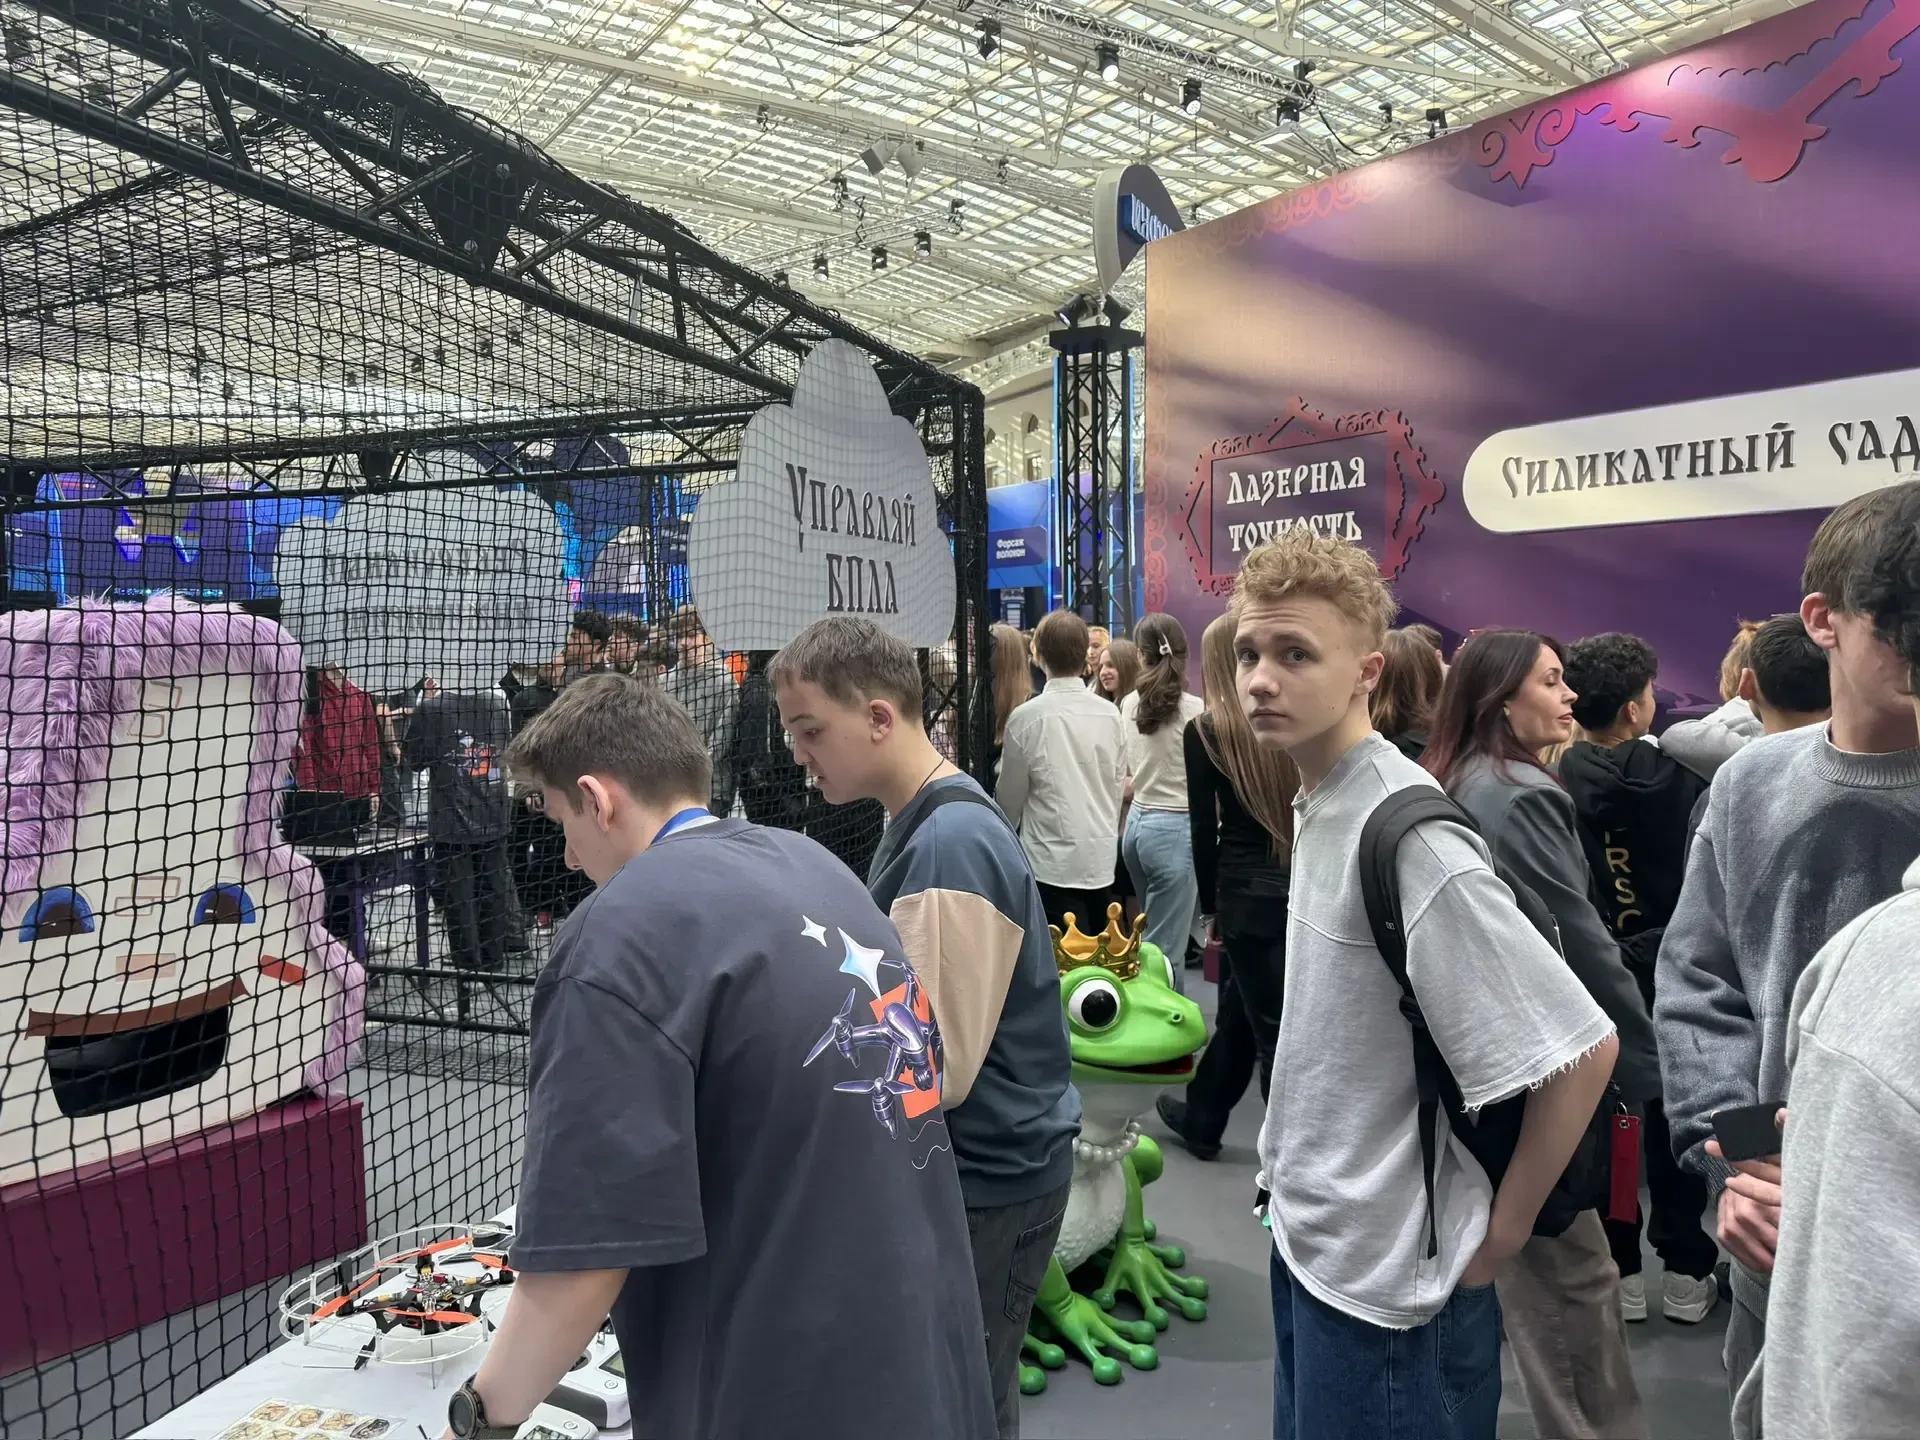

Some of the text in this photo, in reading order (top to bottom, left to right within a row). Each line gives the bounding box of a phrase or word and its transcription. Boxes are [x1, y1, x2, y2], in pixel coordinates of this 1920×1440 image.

[1226, 456, 1367, 507] Лазерная
[1501, 421, 1796, 499] Силикатный
[785, 462, 917, 553] Управляй
[826, 552, 899, 614] БПЛА
